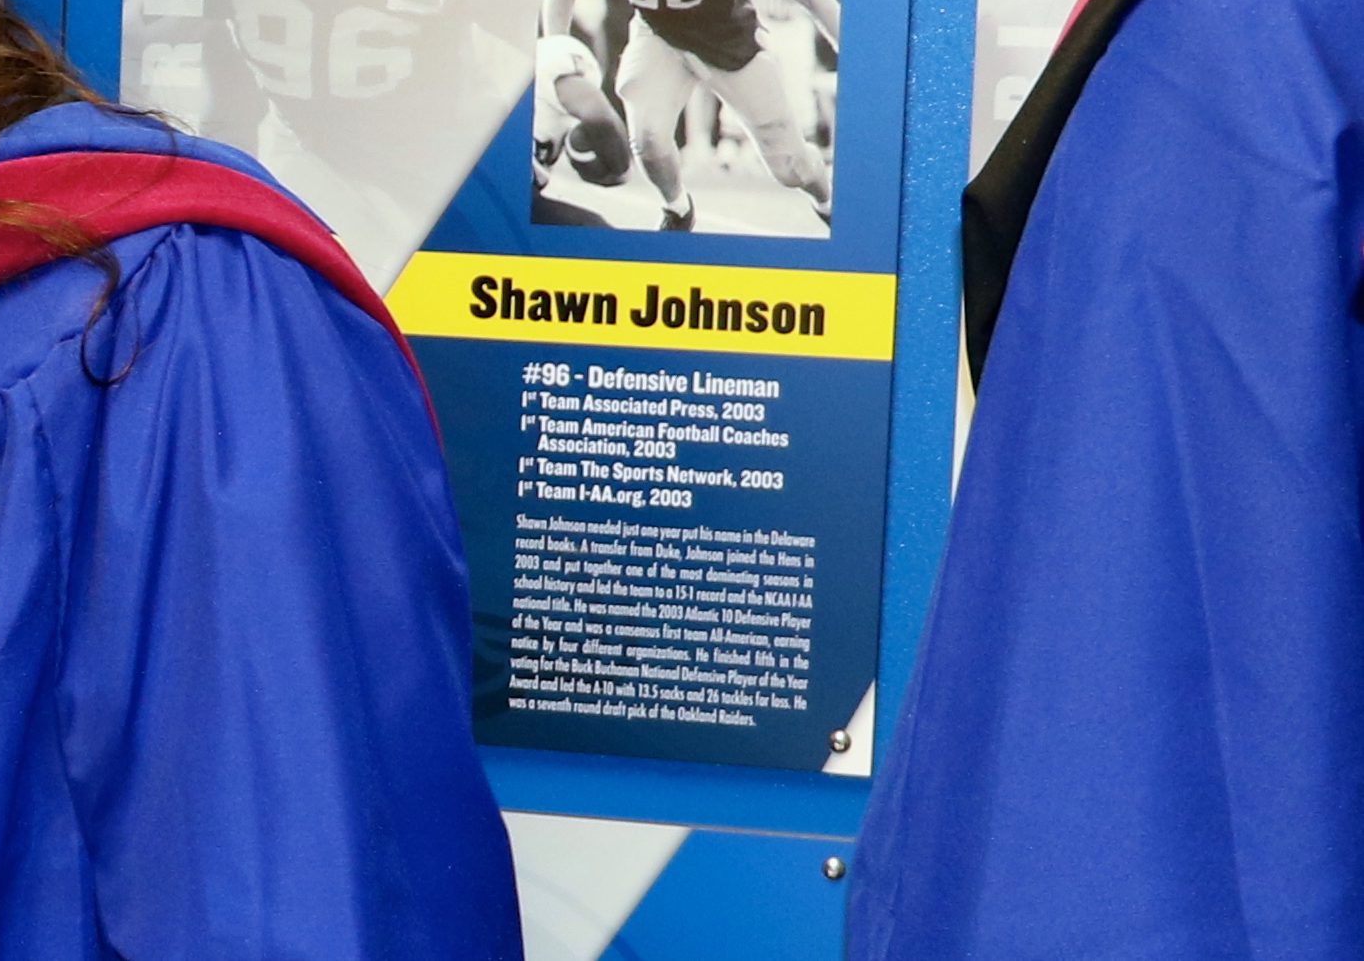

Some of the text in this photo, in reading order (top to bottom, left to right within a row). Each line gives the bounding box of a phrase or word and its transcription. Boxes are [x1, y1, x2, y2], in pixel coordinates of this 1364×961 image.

[469, 275, 825, 336] Shawn Johnson
[522, 362, 570, 387] #96
[587, 365, 688, 393] Defensive
[692, 370, 780, 398] Lineman
[521, 390, 765, 422] 1st Team Associated Press, 2003
[520, 414, 789, 447] 1st Team American Football Coaches
[537, 433, 676, 459] Association, 2003
[518, 456, 784, 490] 1st Team The Sports Network, 2003
[517, 480, 533, 497] 1st
[535, 481, 576, 500] Team
[649, 488, 692, 508] 2003
